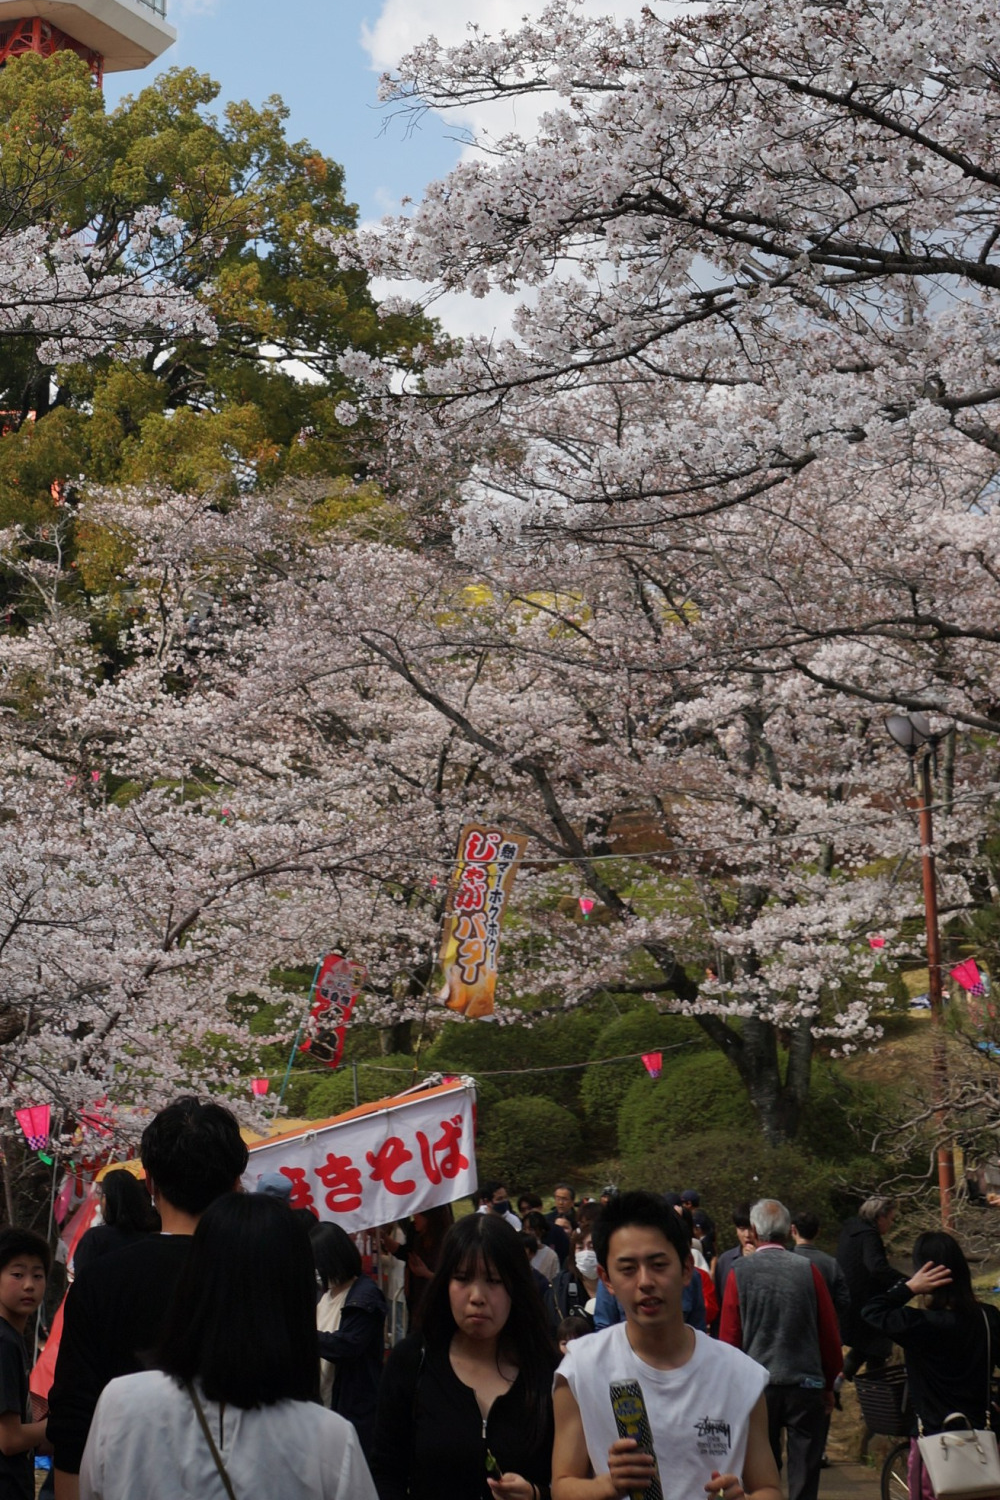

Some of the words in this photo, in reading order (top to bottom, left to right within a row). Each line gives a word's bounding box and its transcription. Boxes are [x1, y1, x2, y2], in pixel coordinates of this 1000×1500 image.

[454, 832, 501, 983] じゃがバター
